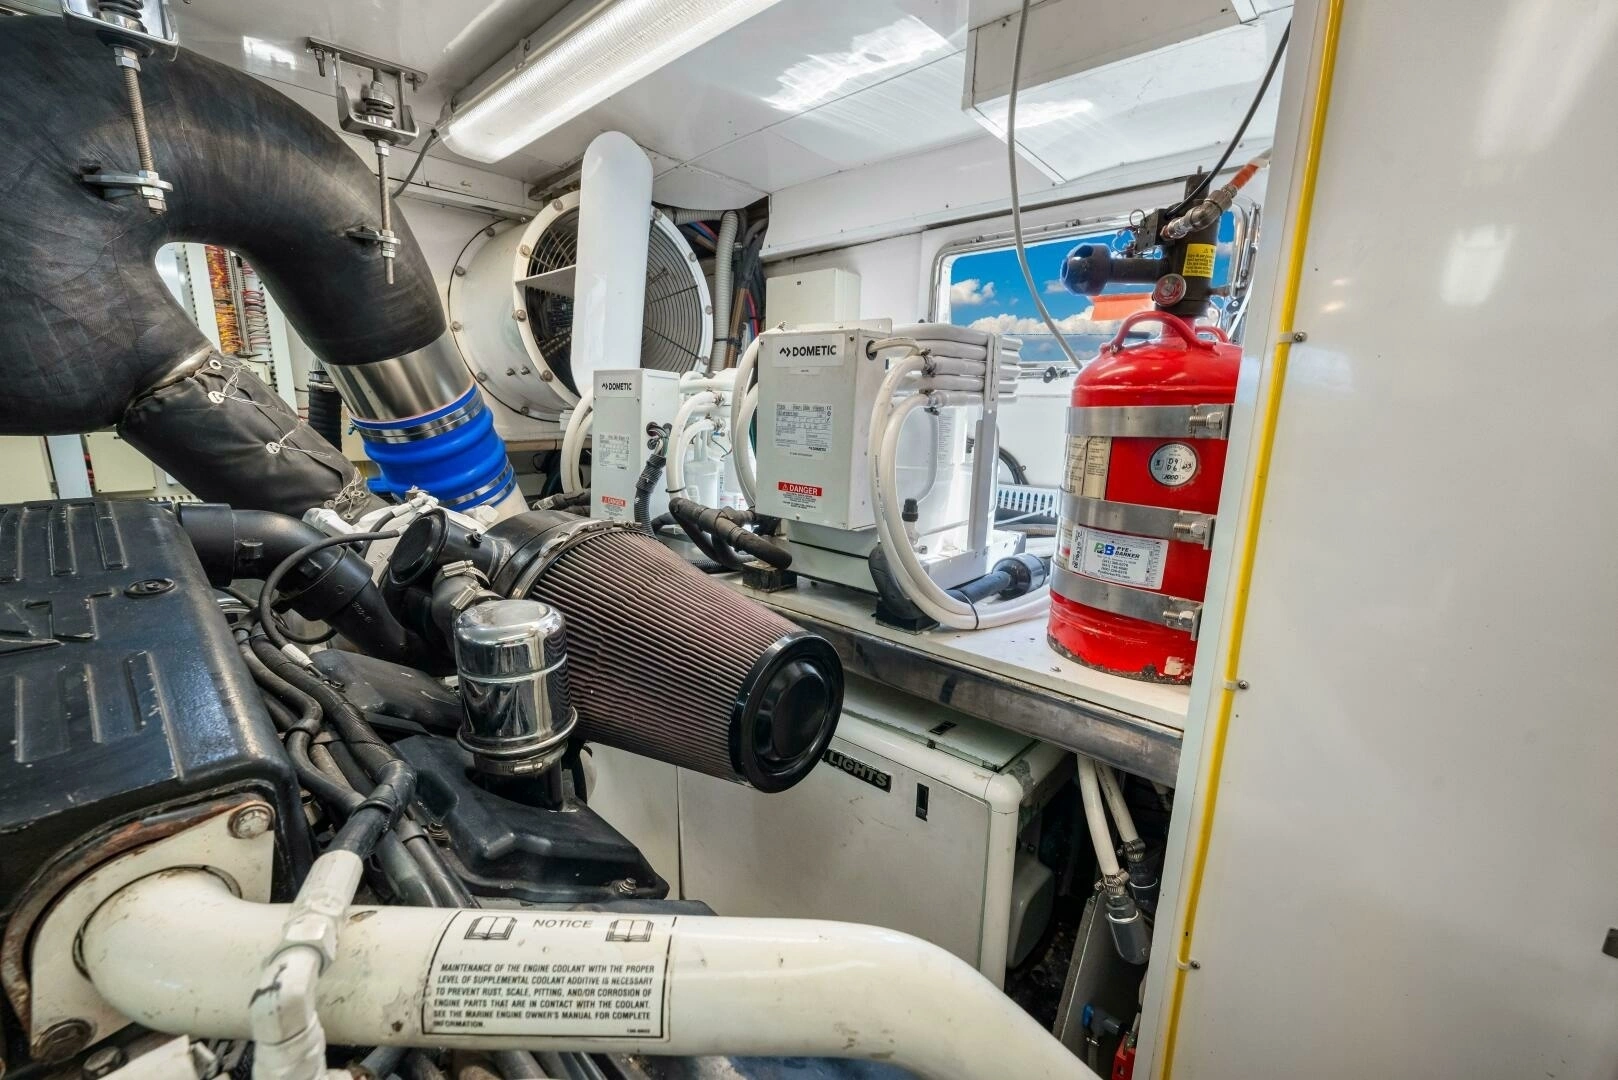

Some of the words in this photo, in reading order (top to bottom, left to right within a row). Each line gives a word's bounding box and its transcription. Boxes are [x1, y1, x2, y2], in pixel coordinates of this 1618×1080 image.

[792, 345, 837, 357] DOMETIC
[608, 382, 632, 391] DOMETIC
[789, 484, 818, 496] DANGER
[828, 751, 888, 787] LIGHTS
[533, 919, 593, 928] NOTICE
[440, 964, 492, 973] MAINTENANCE
[494, 964, 504, 973] OF
[507, 964, 520, 973] THE
[523, 964, 549, 973] ENGINE
[552, 964, 586, 973] COOLANT
[588, 965, 607, 973] WITH
[610, 965, 624, 973] THE
[625, 965, 655, 974] PROPER
[437, 975, 459, 984] LEVEL
[461, 975, 472, 984] OF
[473, 975, 529, 985] SUPPLEMENTAL
[531, 976, 566, 985] COOLANT
[567, 976, 600, 985] ADDITIVE
[601, 977, 609, 985] IS
[611, 977, 653, 985] NECESSARY
[436, 987, 446, 996] TO
[447, 987, 480, 996] PREVENT
[567, 988, 595, 997] AND/OR
[597, 989, 640, 997] CORROSION
[642, 989, 652, 997] OF
[434, 999, 460, 1008] ENGINE
[463, 999, 487, 1008] PARTS
[491, 1000, 509, 1008] THAT
[511, 1000, 525, 1008] ARE
[529, 1000, 537, 1008] IN
[540, 1000, 573, 1009] CONTACT
[576, 1000, 595, 1009] WITH
[599, 1001, 612, 1009] THE
[433, 1010, 446, 1018] SEE
[449, 1010, 462, 1018] THE
[465, 1010, 494, 1019] MARINE
[496, 1011, 525, 1019] ENGINE
[525, 1011, 559, 1019] OWNER'S
[561, 1012, 592, 1020] MANUAL
[595, 1012, 610, 1020] FOR
[612, 1012, 650, 1020] COMPLETE
